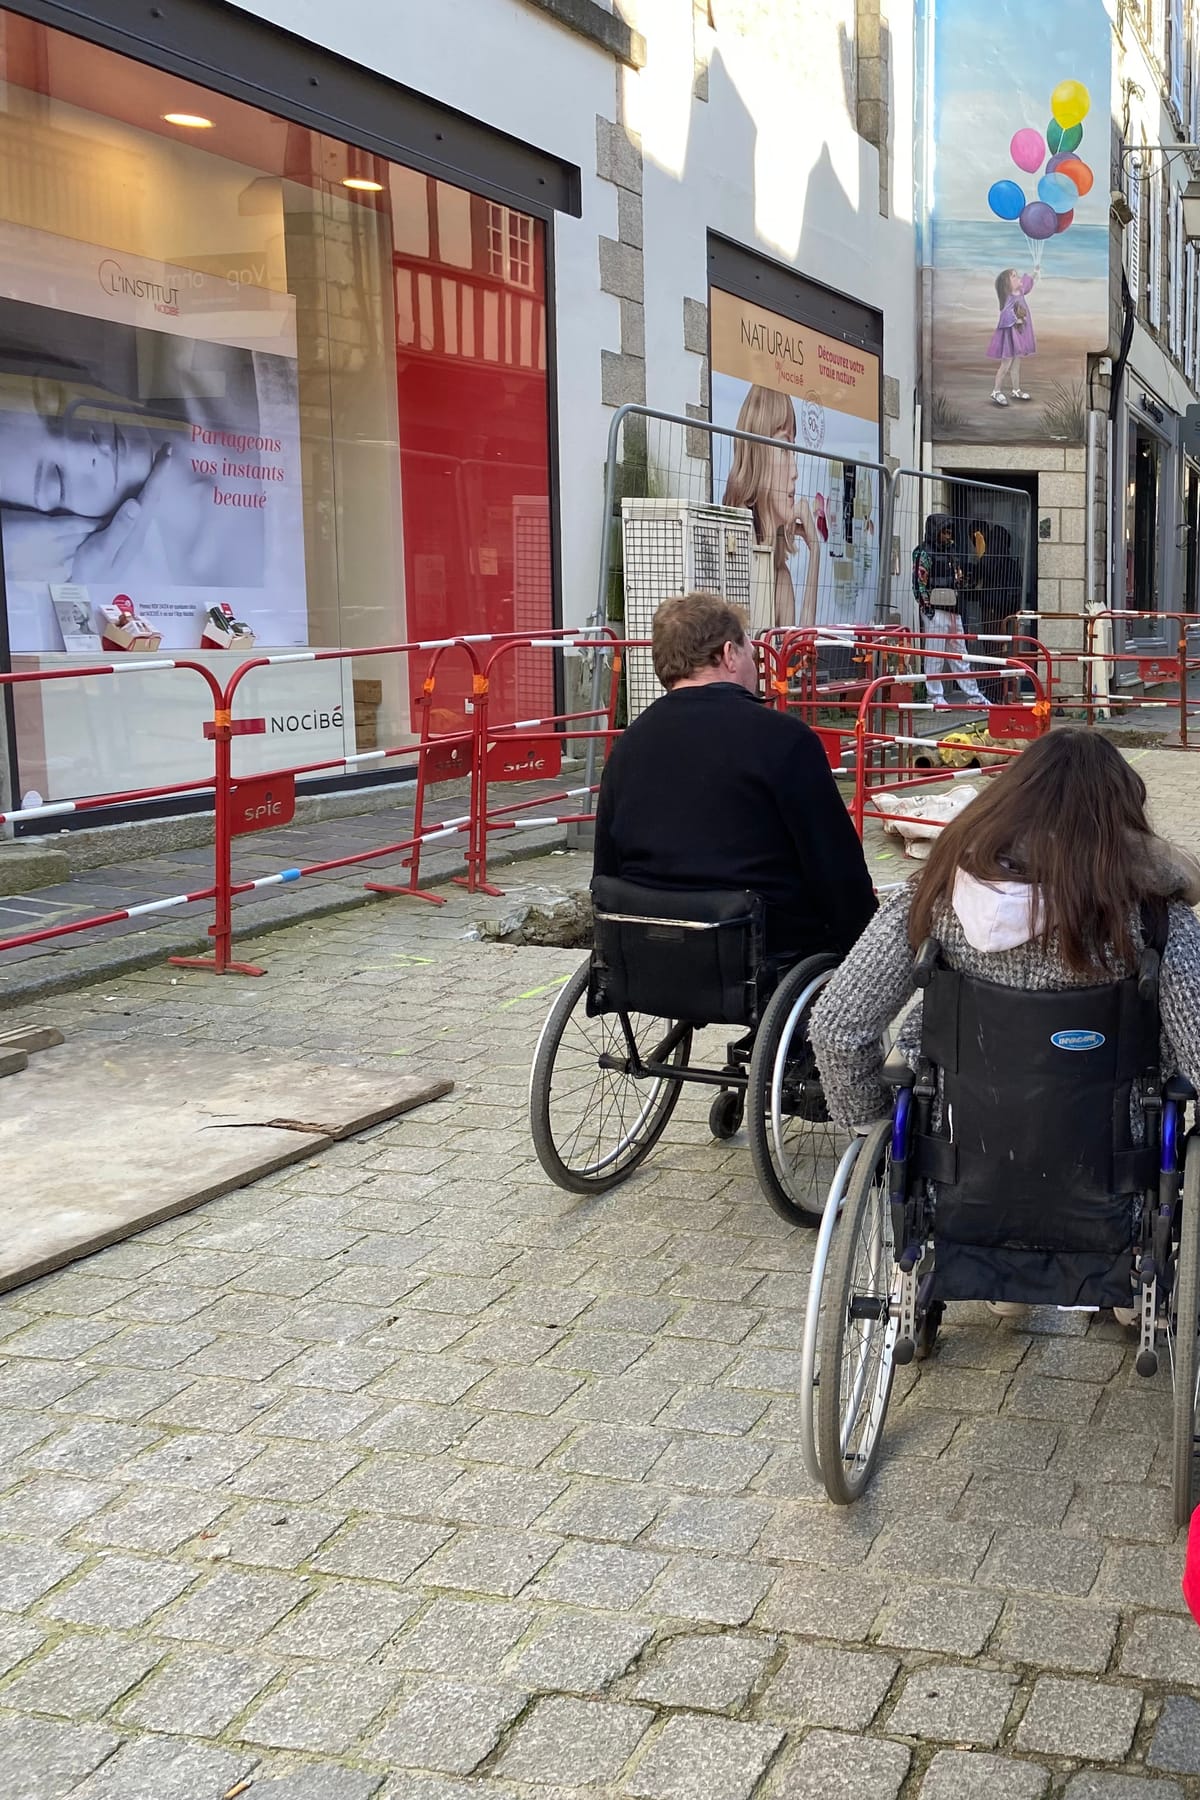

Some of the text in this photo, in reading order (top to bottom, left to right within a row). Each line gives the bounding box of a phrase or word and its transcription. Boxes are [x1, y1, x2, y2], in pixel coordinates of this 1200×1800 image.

[111, 273, 180, 307] L'INSTITUT
[740, 317, 805, 366] NATURALS
[817, 344, 865, 376] Découvrez votre
[818, 363, 856, 388] vraie nature
[191, 423, 282, 454] Partageons
[190, 457, 285, 482] vos instants
[212, 485, 268, 509] beauté
